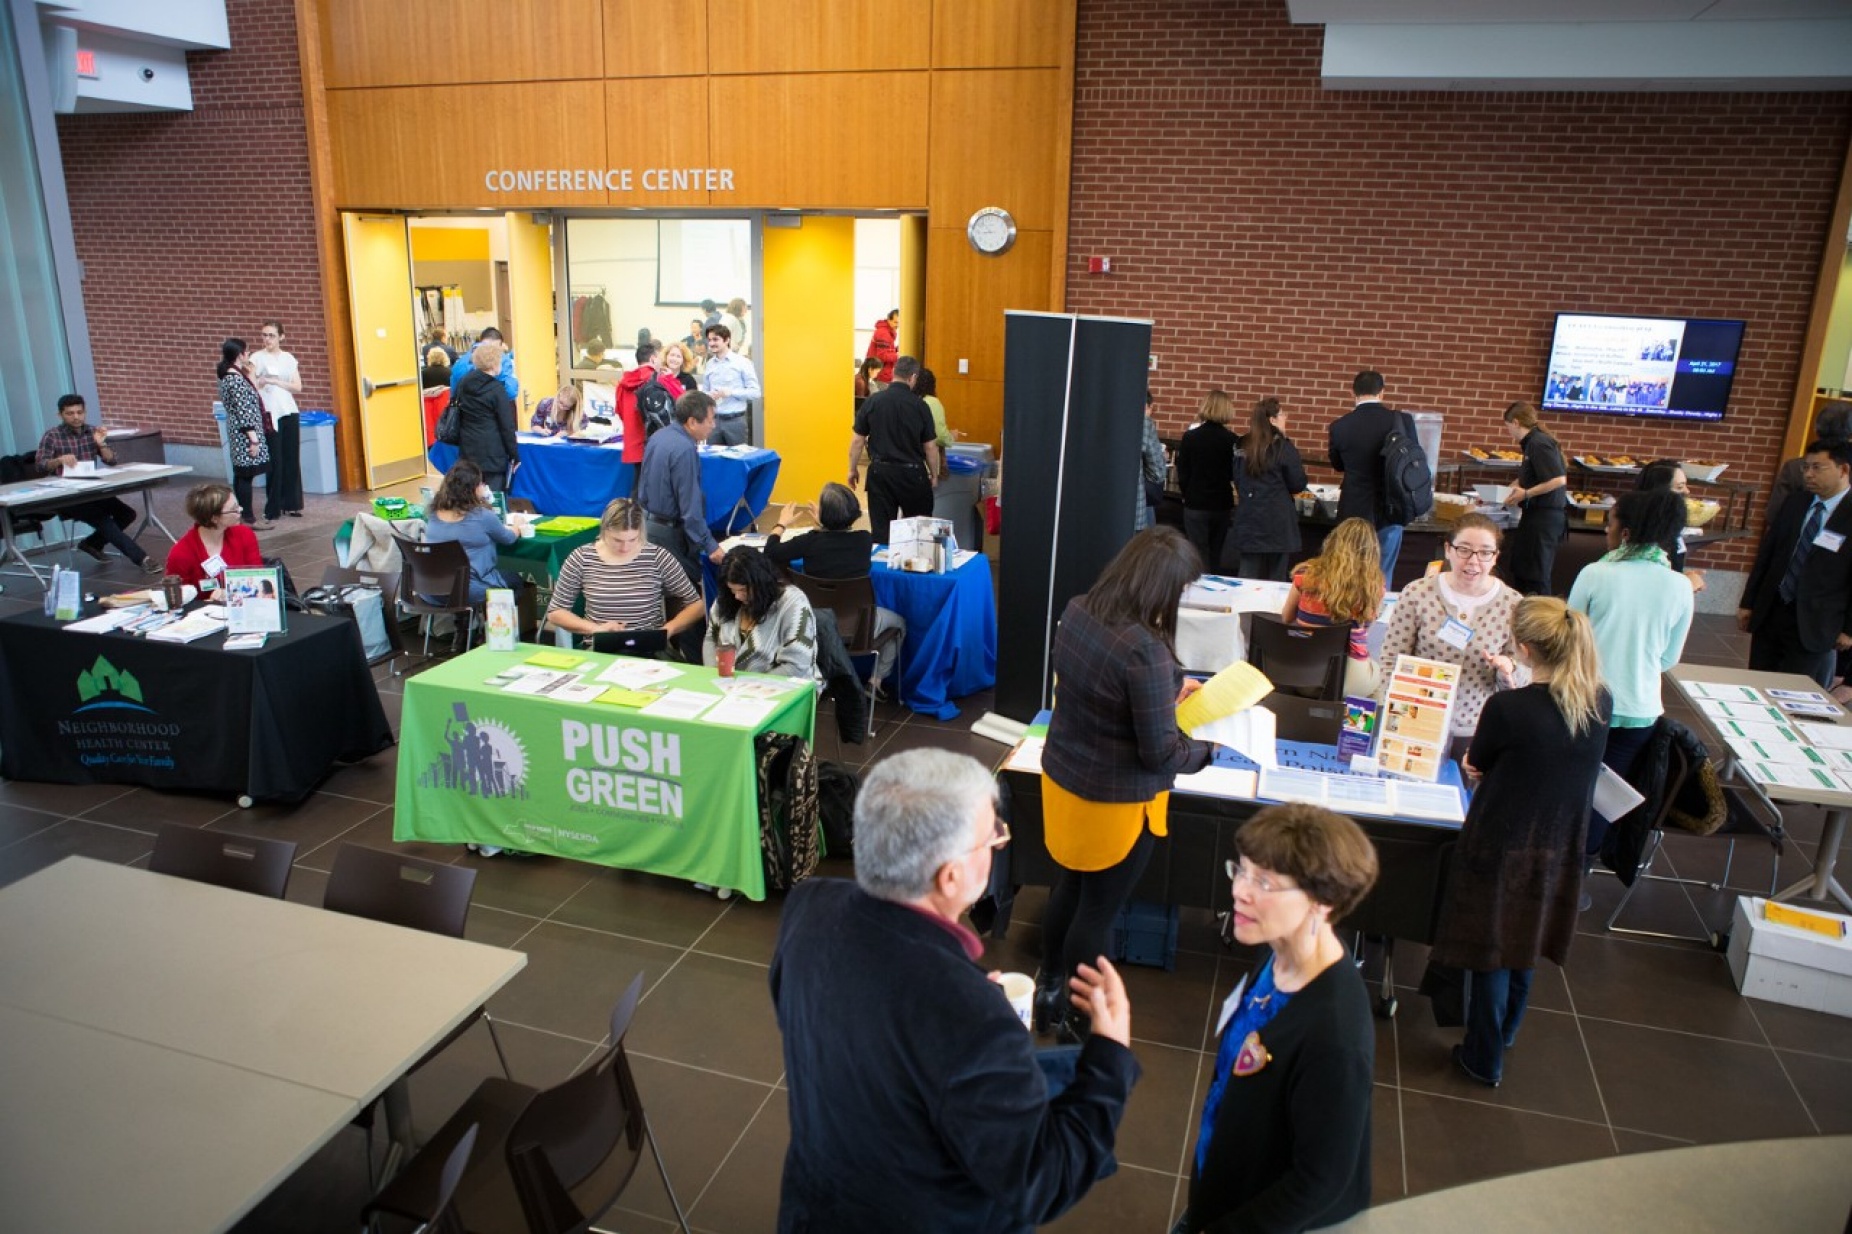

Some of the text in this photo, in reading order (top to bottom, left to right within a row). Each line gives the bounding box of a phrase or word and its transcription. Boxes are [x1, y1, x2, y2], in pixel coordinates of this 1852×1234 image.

[485, 168, 735, 191] CONFERENCE CENTER
[76, 738, 124, 749] HEALTH
[562, 719, 681, 776] PUSH
[566, 768, 683, 818] GREEN
